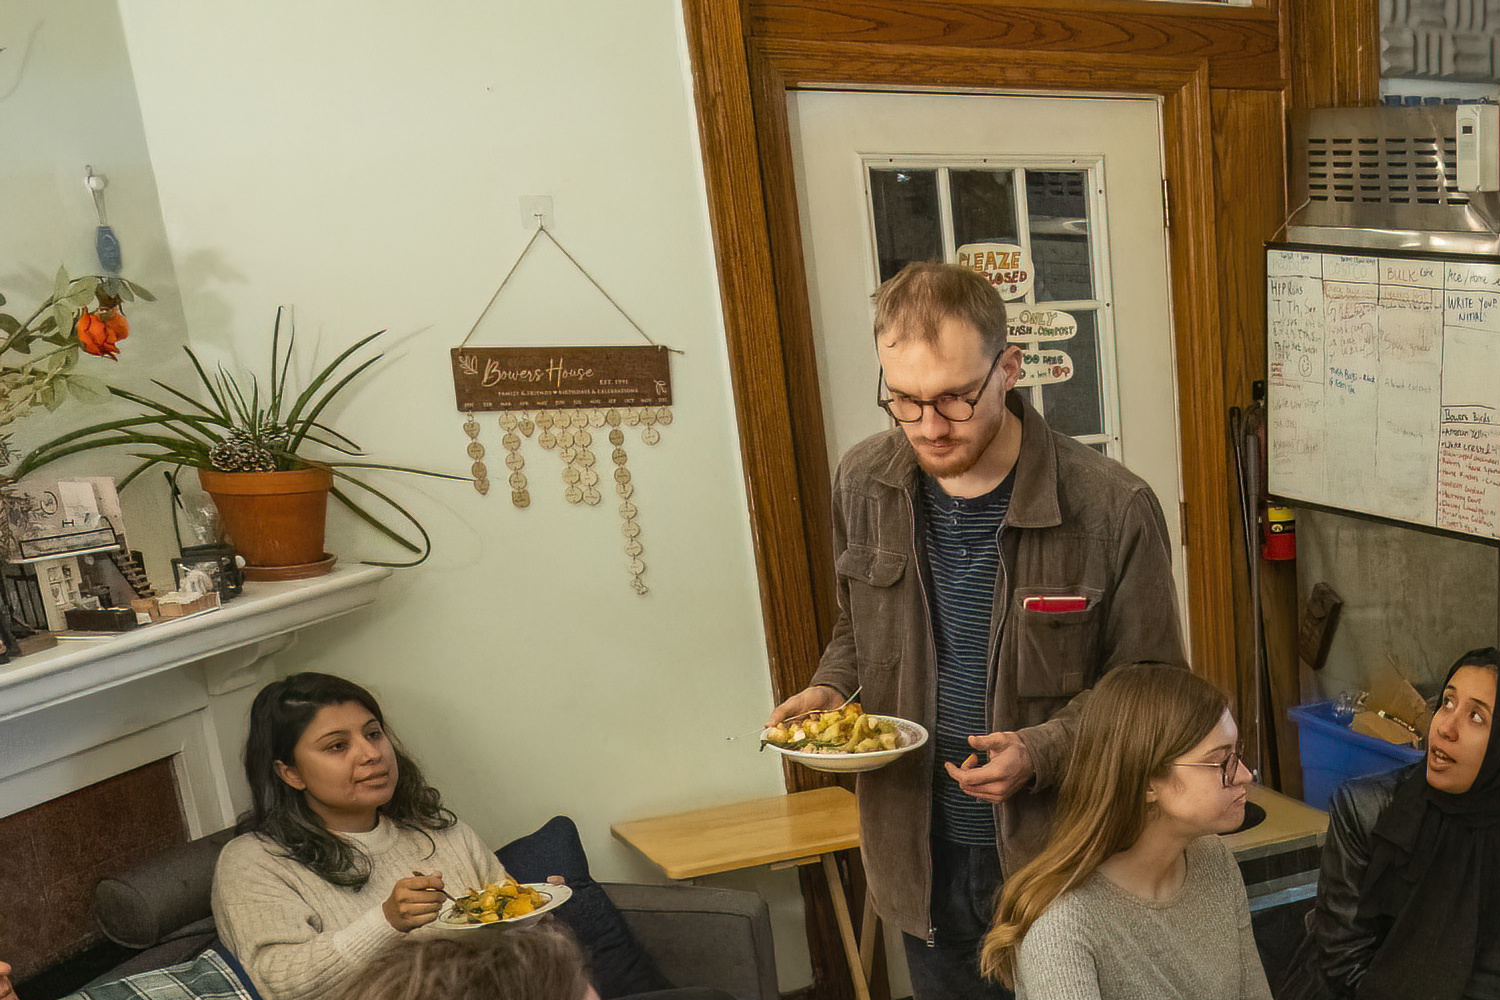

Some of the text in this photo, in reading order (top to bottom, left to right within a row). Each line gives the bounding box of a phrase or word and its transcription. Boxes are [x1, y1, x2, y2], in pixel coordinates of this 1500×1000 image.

[1387, 267, 1418, 282] BULK
[1448, 295, 1473, 310] WRITE
[1019, 310, 1057, 327] ONLY
[1037, 325, 1075, 337] COMPOST
[481, 357, 594, 388] Bowers House
